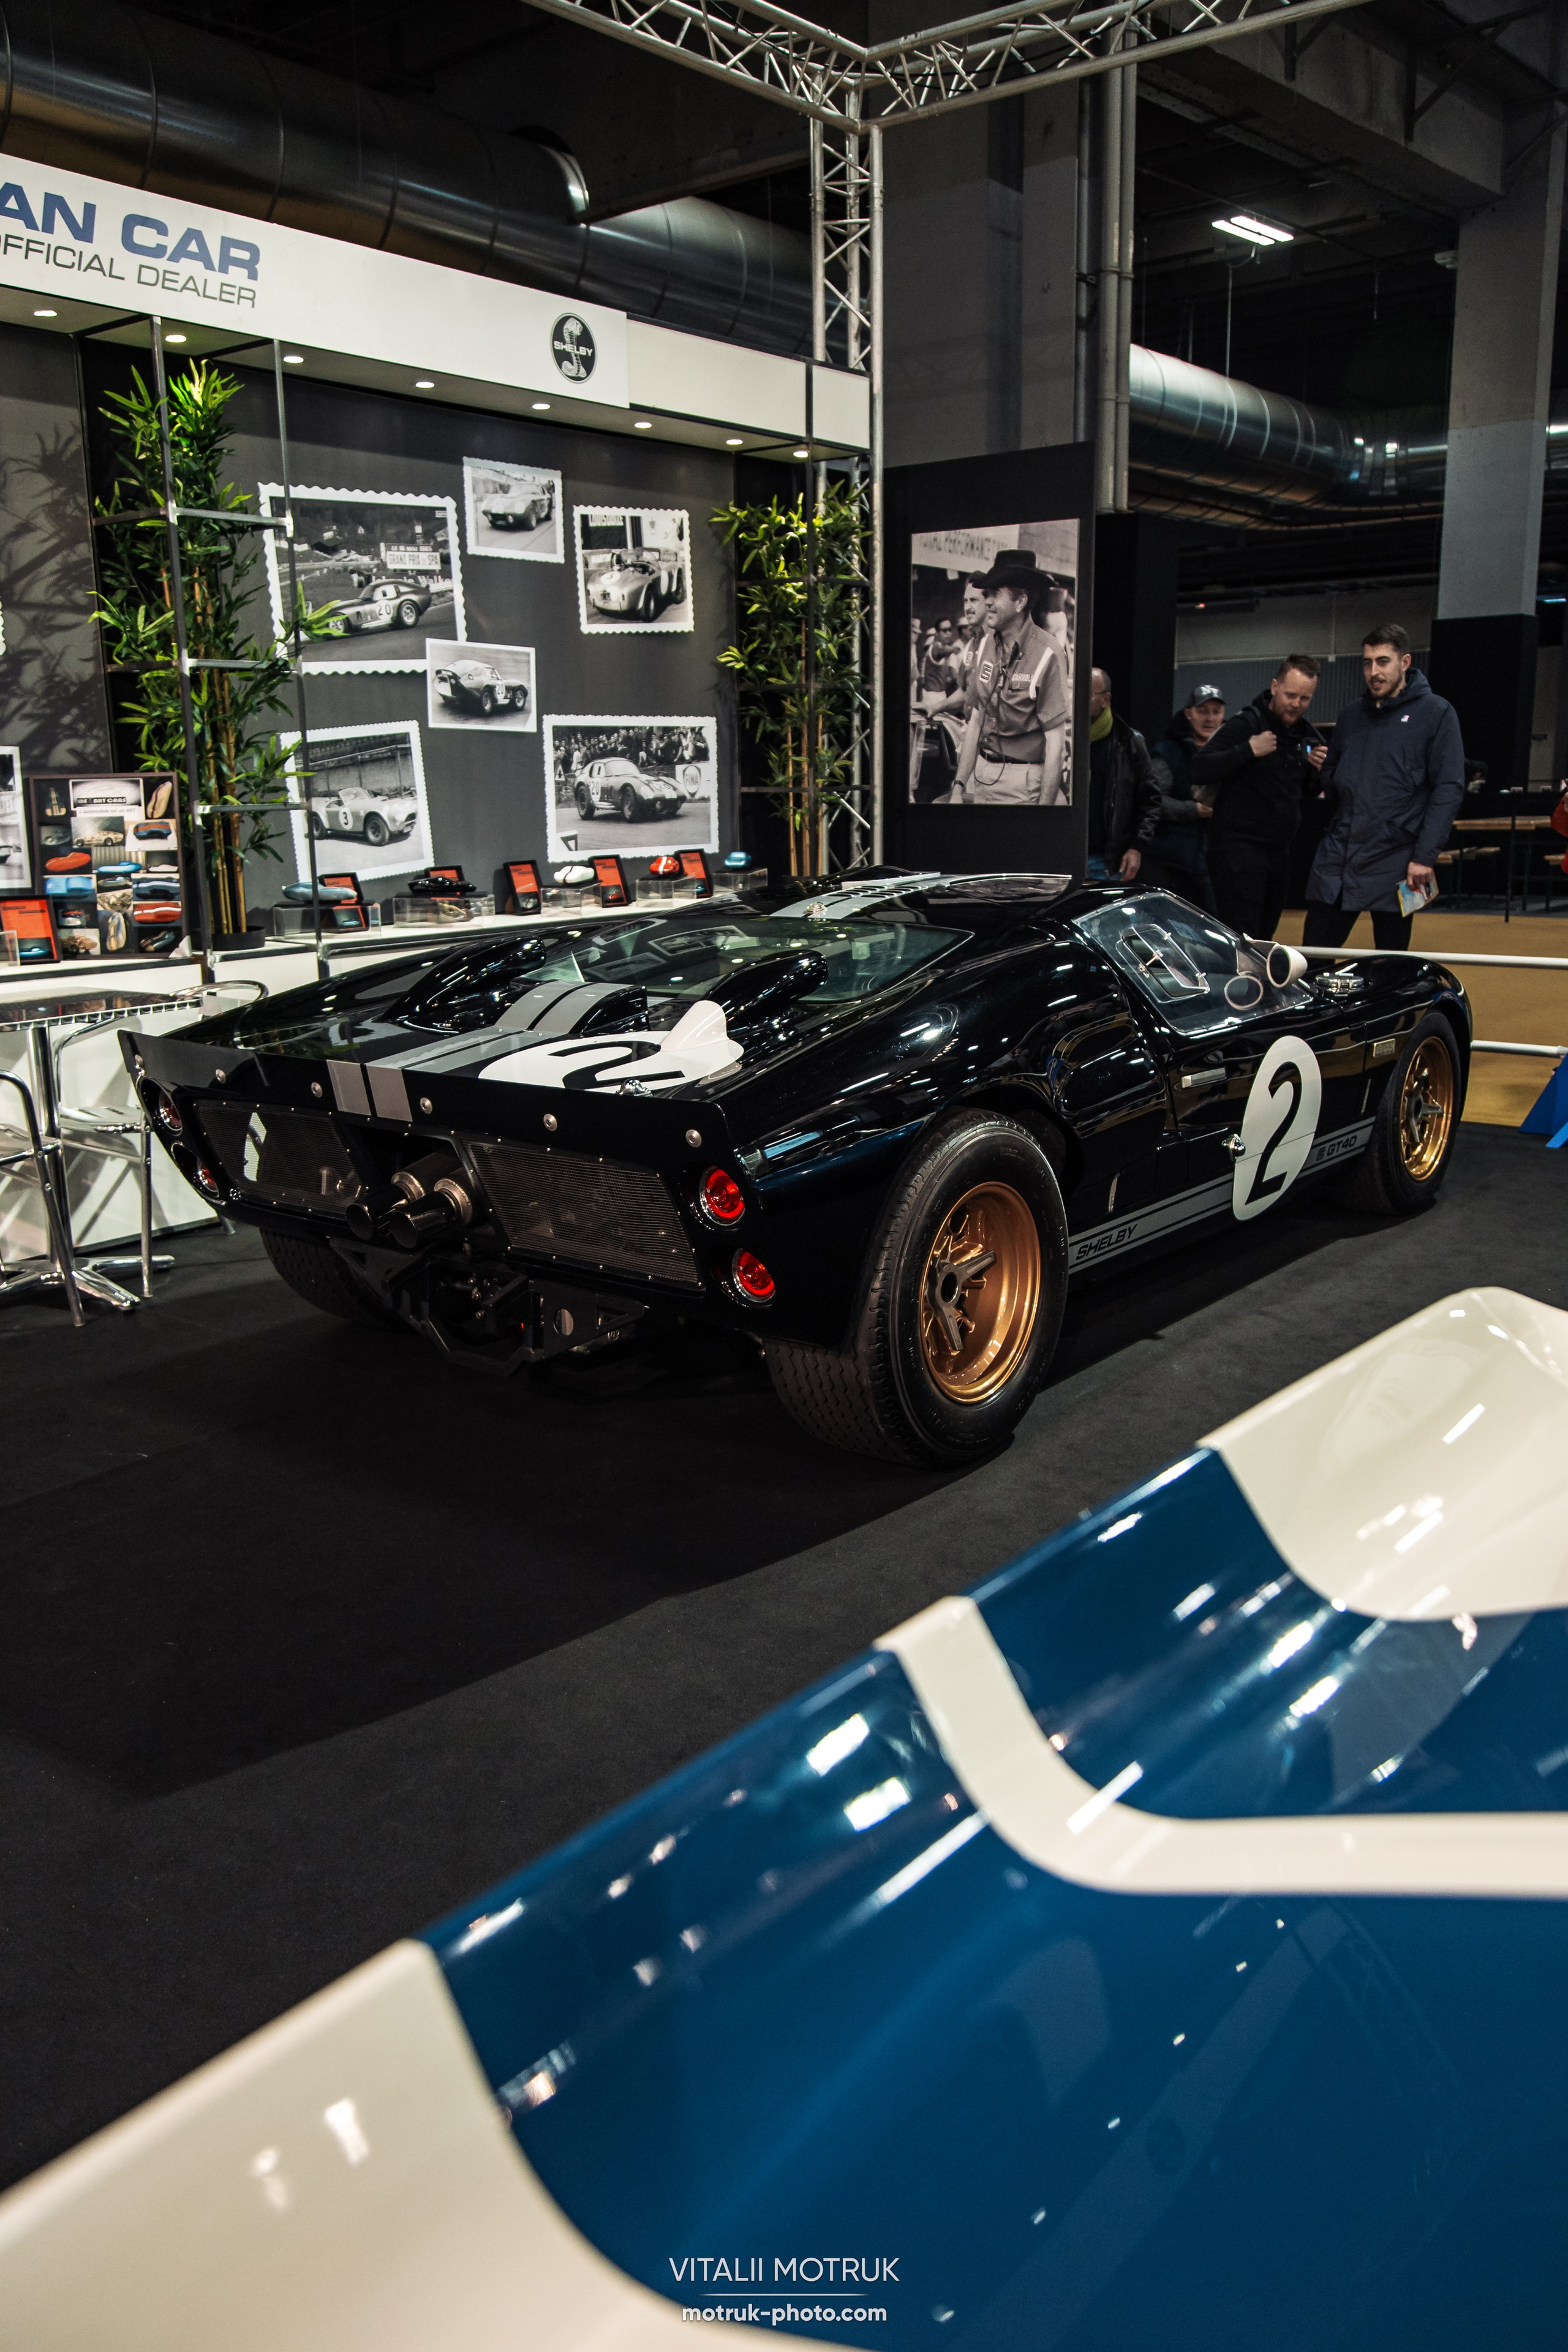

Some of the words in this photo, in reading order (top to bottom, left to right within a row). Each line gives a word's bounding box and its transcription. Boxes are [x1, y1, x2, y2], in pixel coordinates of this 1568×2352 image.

[0, 182, 96, 244] AN
[121, 213, 260, 281] CAR
[0, 233, 125, 281] FFICIAL
[137, 264, 256, 308] DEALER
[554, 341, 593, 356] SHELBY
[389, 554, 406, 565] GRAND
[428, 554, 439, 565] SPA
[378, 603, 391, 616] 20
[591, 780, 600, 795] 20
[685, 772, 699, 785] FINA
[343, 811, 350, 826] 3
[547, 1040, 685, 1090] 2
[1245, 1061, 1303, 1206] 2
[1327, 1134, 1358, 1156] GT40
[1076, 1223, 1138, 1261] SHELBY
